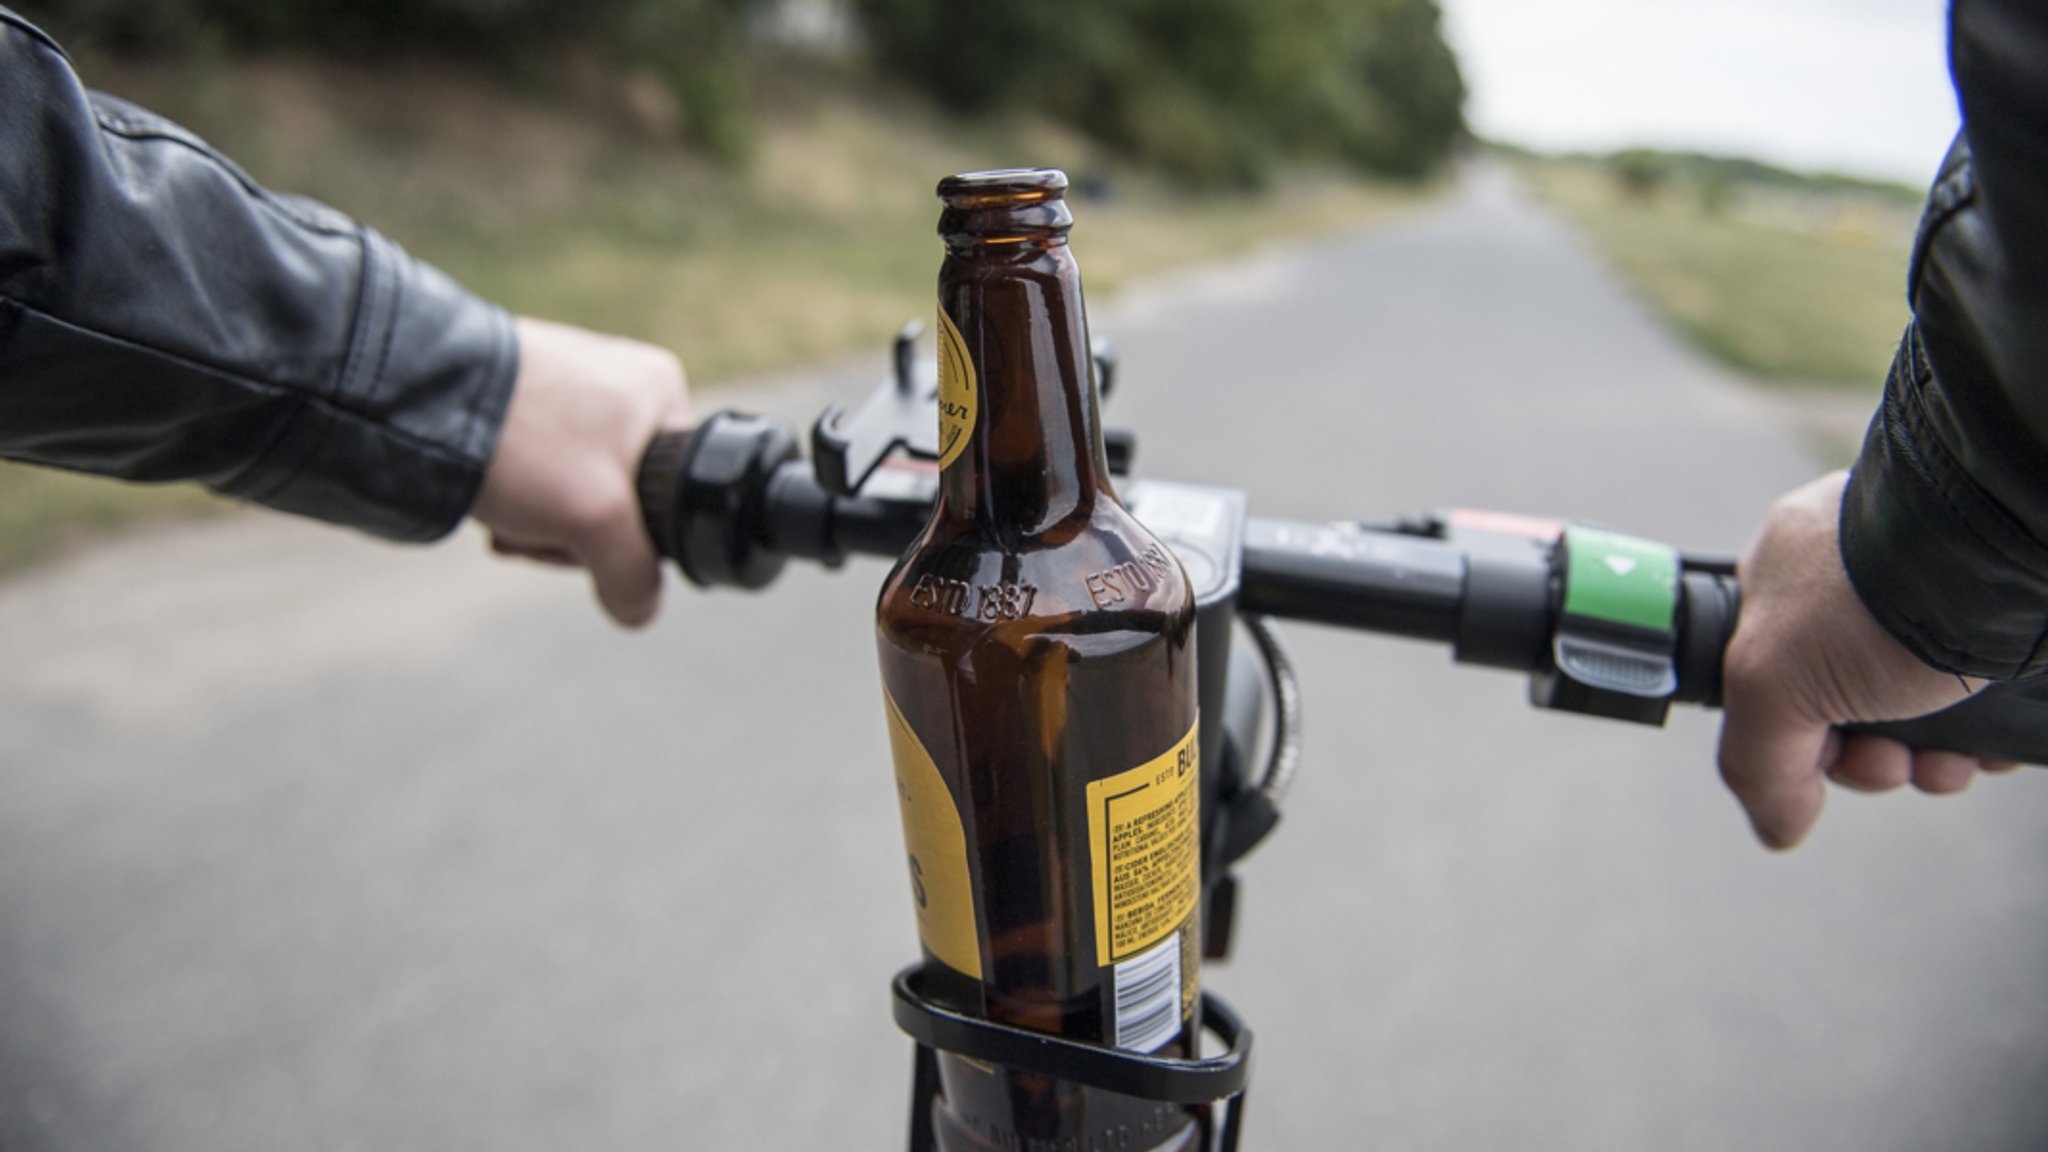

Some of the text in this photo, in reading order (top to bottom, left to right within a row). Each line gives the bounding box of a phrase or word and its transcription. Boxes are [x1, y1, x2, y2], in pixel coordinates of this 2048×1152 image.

[1085, 561, 1149, 609] ESTD
[910, 573, 1038, 620] ESTD 1887
[1133, 799, 1172, 826] REFRESHING
[1125, 855, 1147, 870] CIDER
[1114, 872, 1129, 882] AUS
[1127, 901, 1154, 918] BEBIDA
